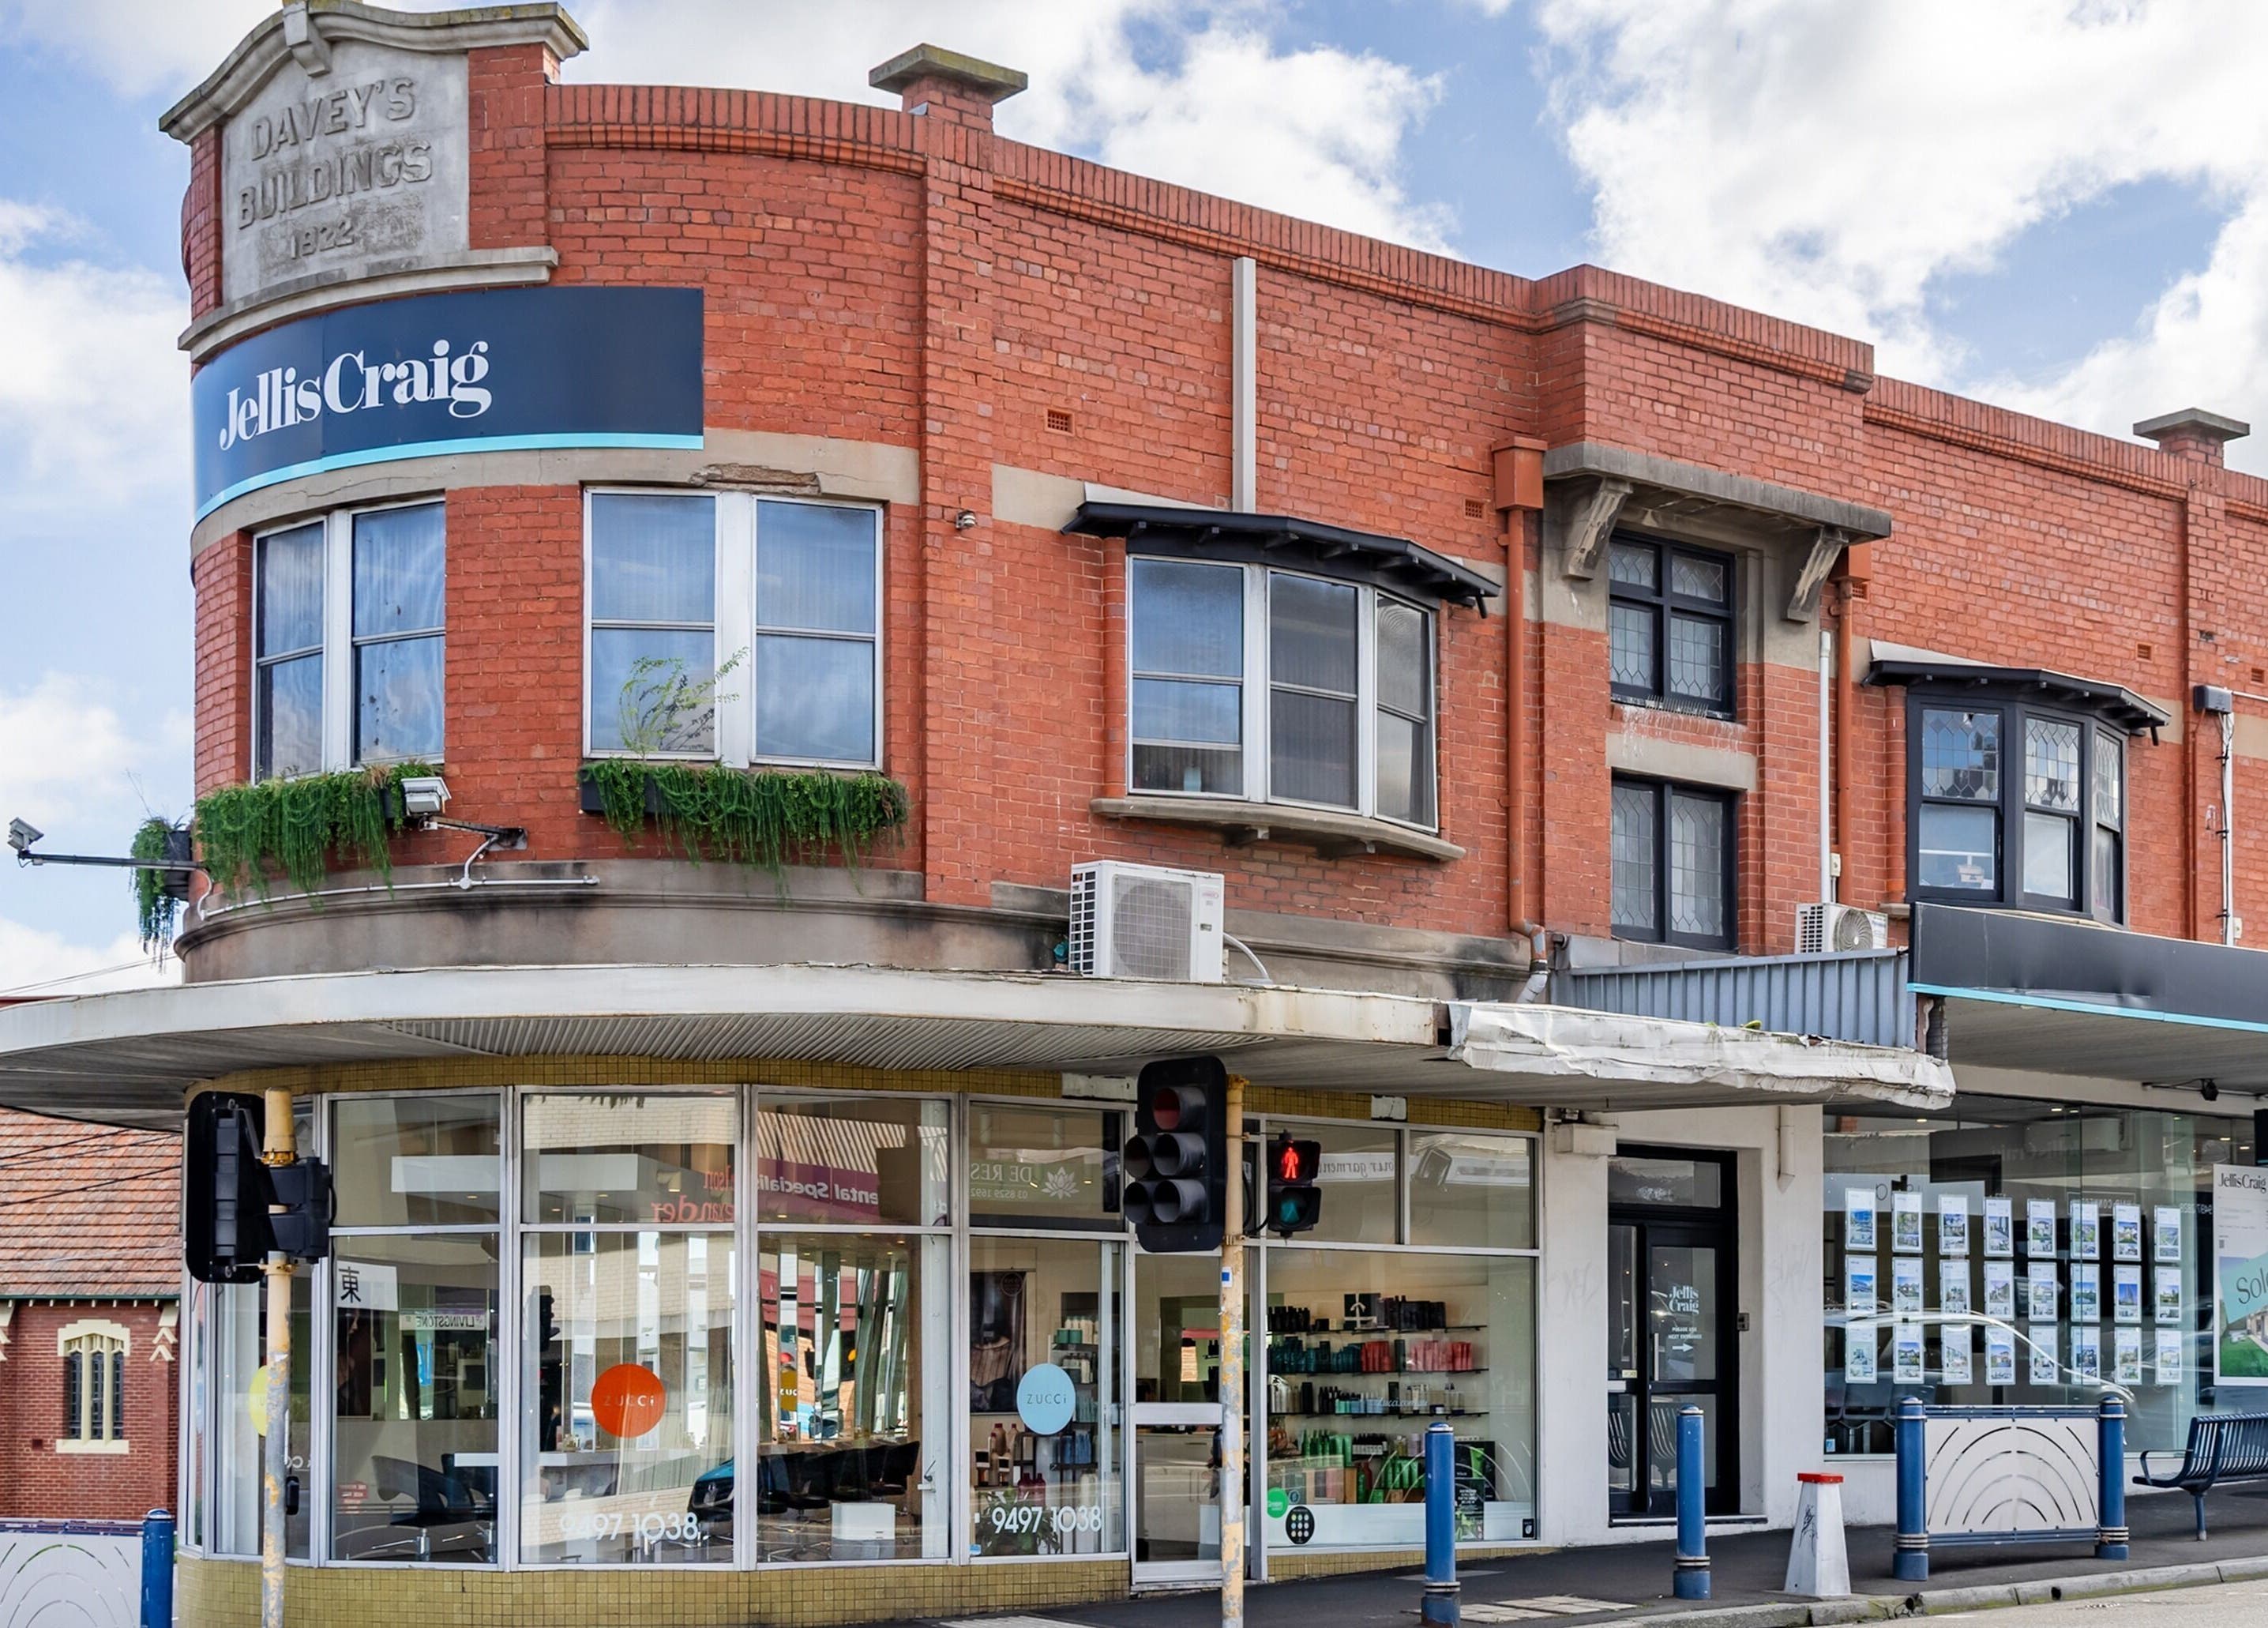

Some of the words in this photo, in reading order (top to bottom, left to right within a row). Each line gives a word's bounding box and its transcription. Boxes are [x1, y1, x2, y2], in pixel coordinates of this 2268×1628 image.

[251, 77, 415, 161] DAVEY'S
[239, 138, 433, 230] BUILDINGS
[338, 1266, 362, 1303] 東
[1669, 1286, 1699, 1299] Jellis
[2236, 1267, 2268, 1305] Sol
[1669, 1298, 1700, 1314] Craig
[560, 1513, 622, 1541] 9497
[631, 1512, 698, 1541] 1038
[991, 1506, 1044, 1534] 9497
[1051, 1506, 1102, 1533] 1038
